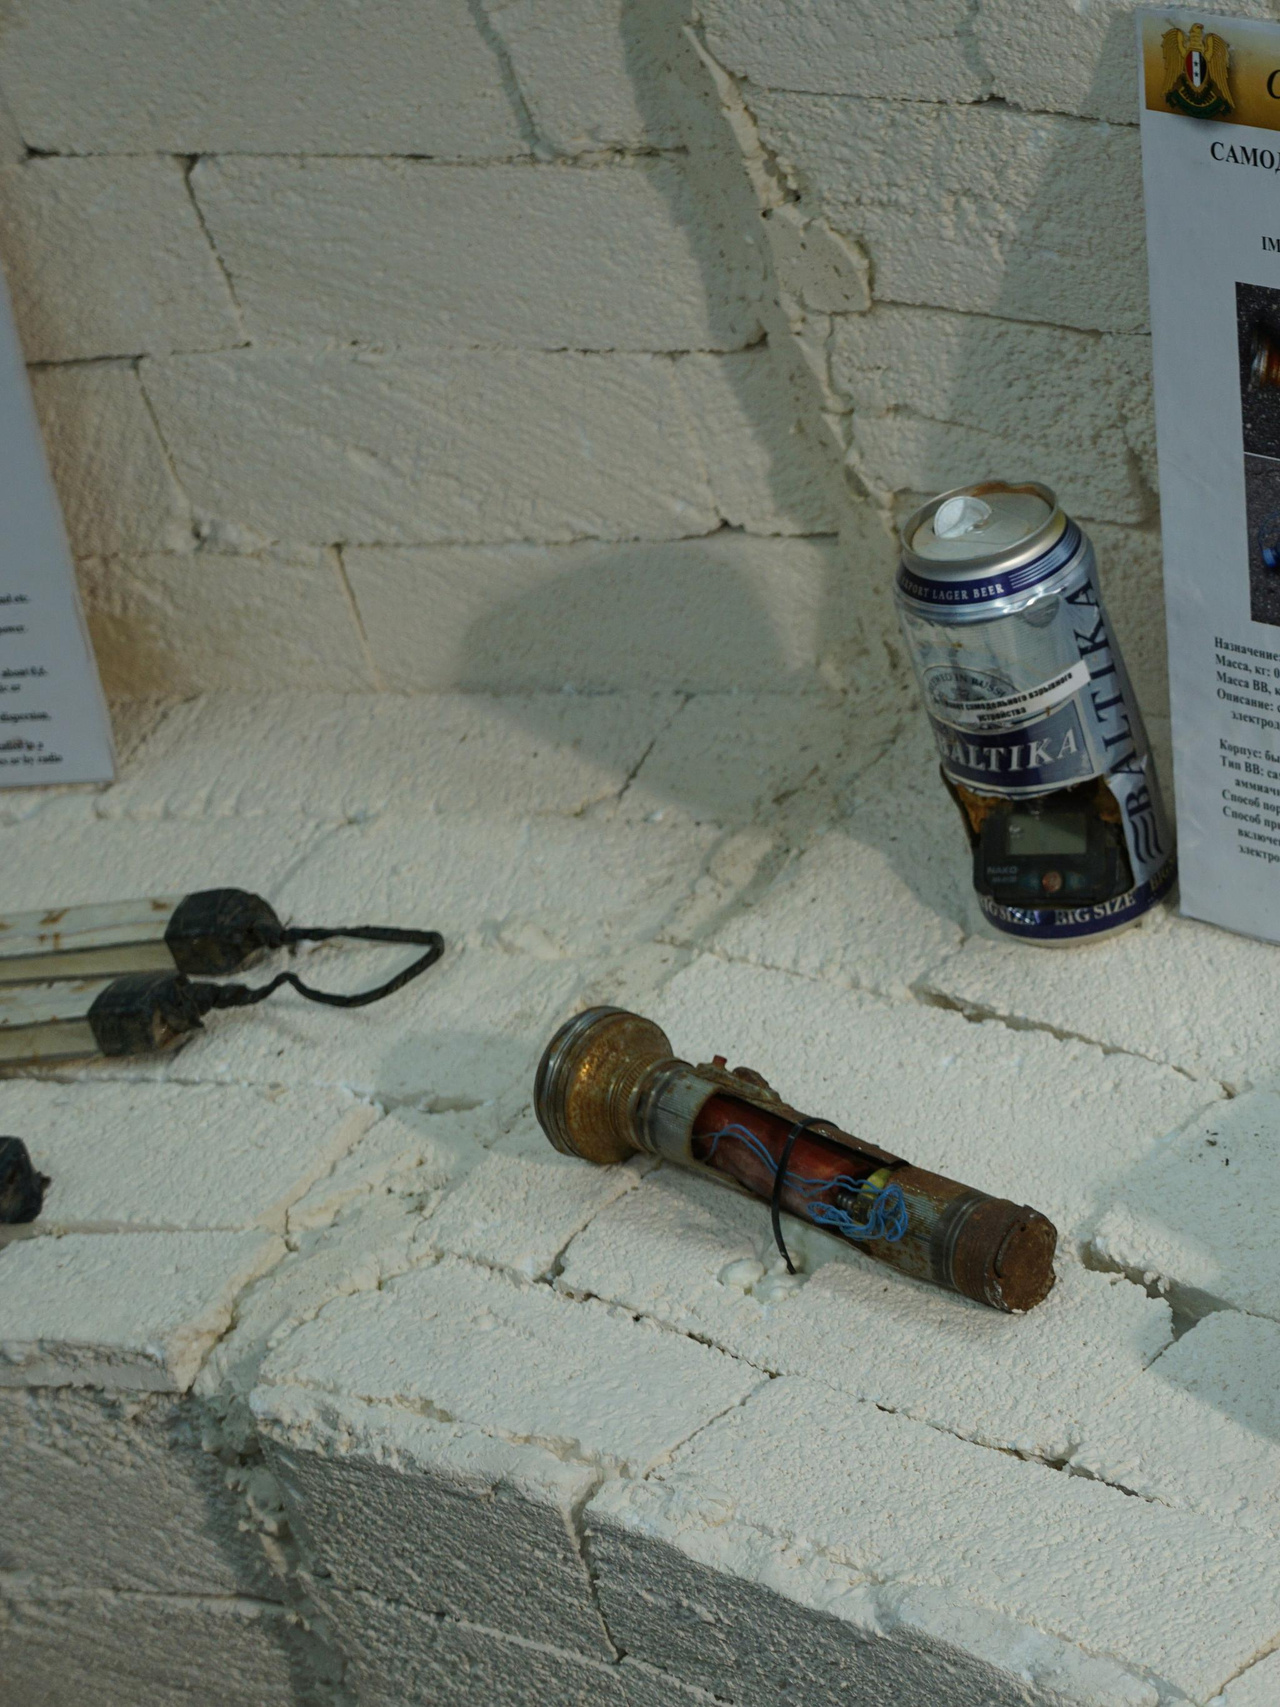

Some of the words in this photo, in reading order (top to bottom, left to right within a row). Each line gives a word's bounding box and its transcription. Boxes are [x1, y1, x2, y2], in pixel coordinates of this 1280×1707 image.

[932, 589, 969, 600] LAGER
[973, 583, 1005, 598] BEER
[1215, 653, 1252, 673] Масса,
[1254, 665, 1270, 676] кг:
[1216, 670, 1249, 688] Масса
[1252, 678, 1271, 695] ВВ,
[1065, 578, 1151, 818] BALTIKA
[1216, 687, 1273, 711] Описание:
[935, 728, 1079, 772] BALTIKA
[1219, 738, 1261, 759] Корпус:
[1221, 755, 1241, 770] Тип
[1244, 760, 1264, 776] ВВ:
[1054, 906, 1091, 926] BIG
[1093, 892, 1136, 920] SIZE
